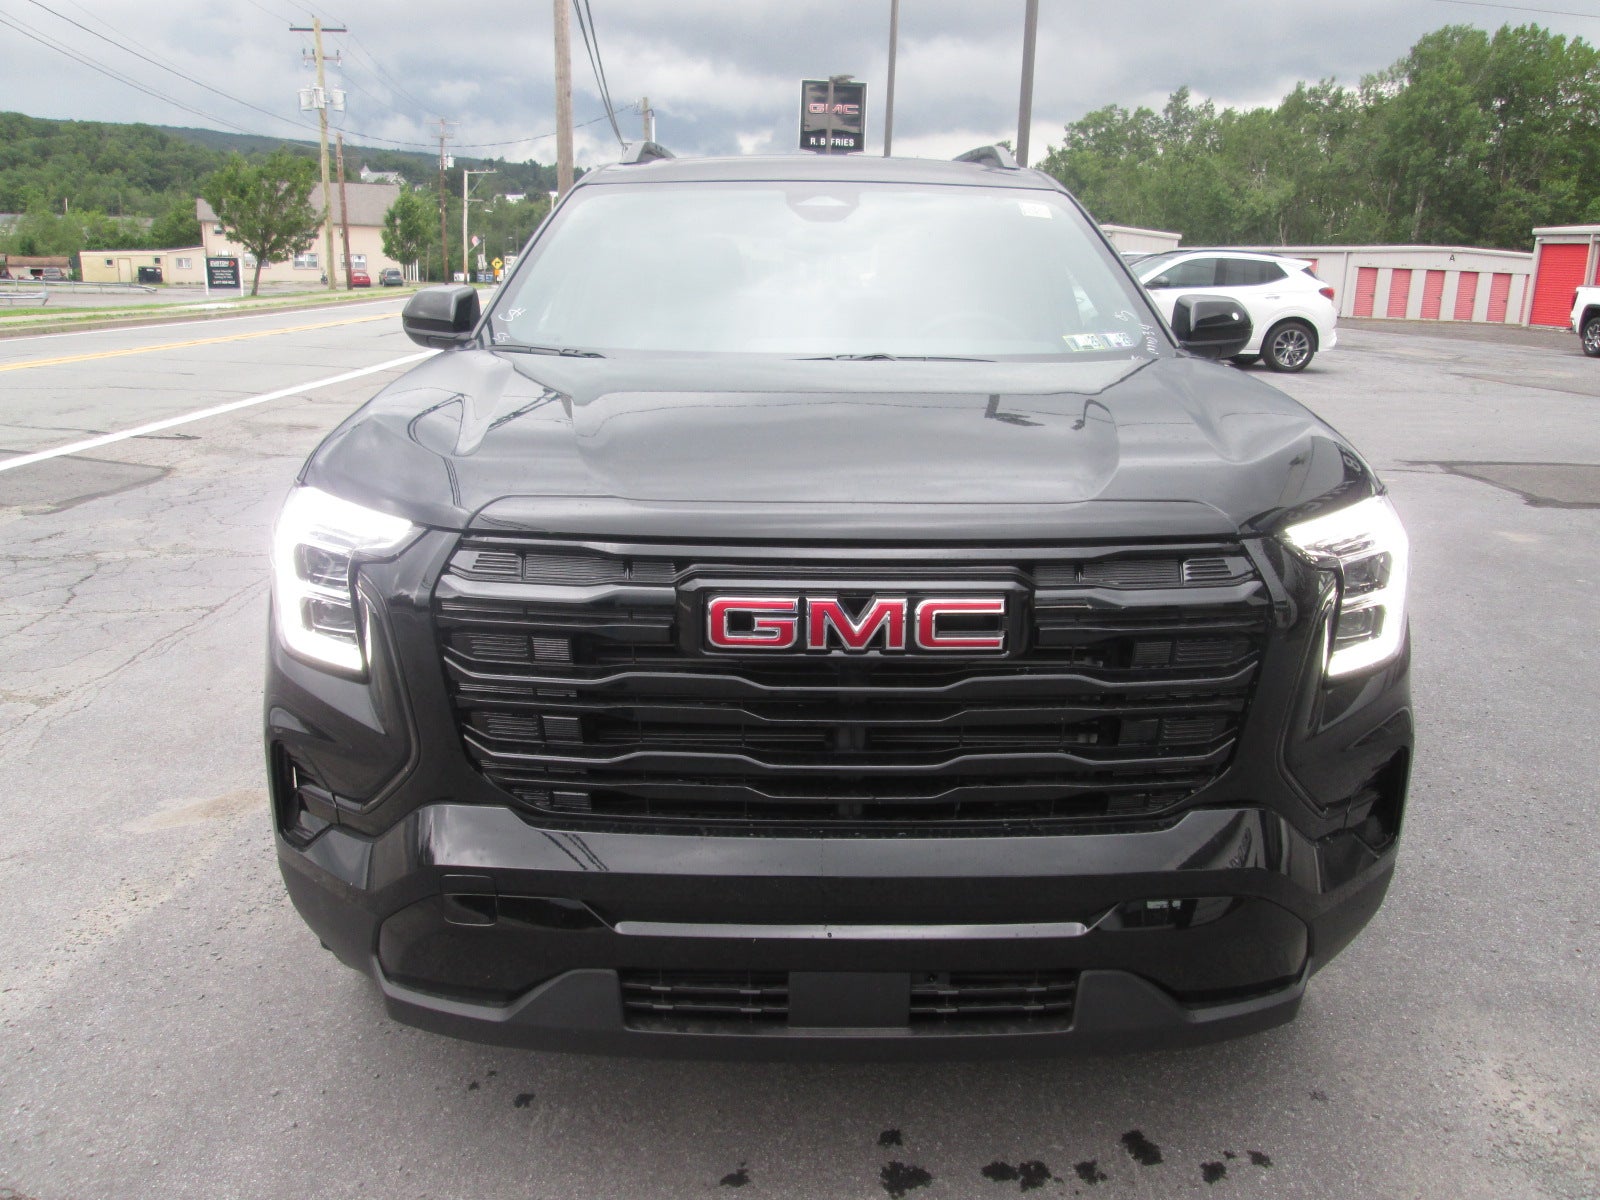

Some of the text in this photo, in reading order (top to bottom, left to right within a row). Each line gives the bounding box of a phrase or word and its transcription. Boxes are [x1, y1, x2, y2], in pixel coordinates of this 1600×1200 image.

[830, 138, 855, 147] FRIES
[1449, 254, 1456, 262] A
[707, 595, 1006, 650] GMC
